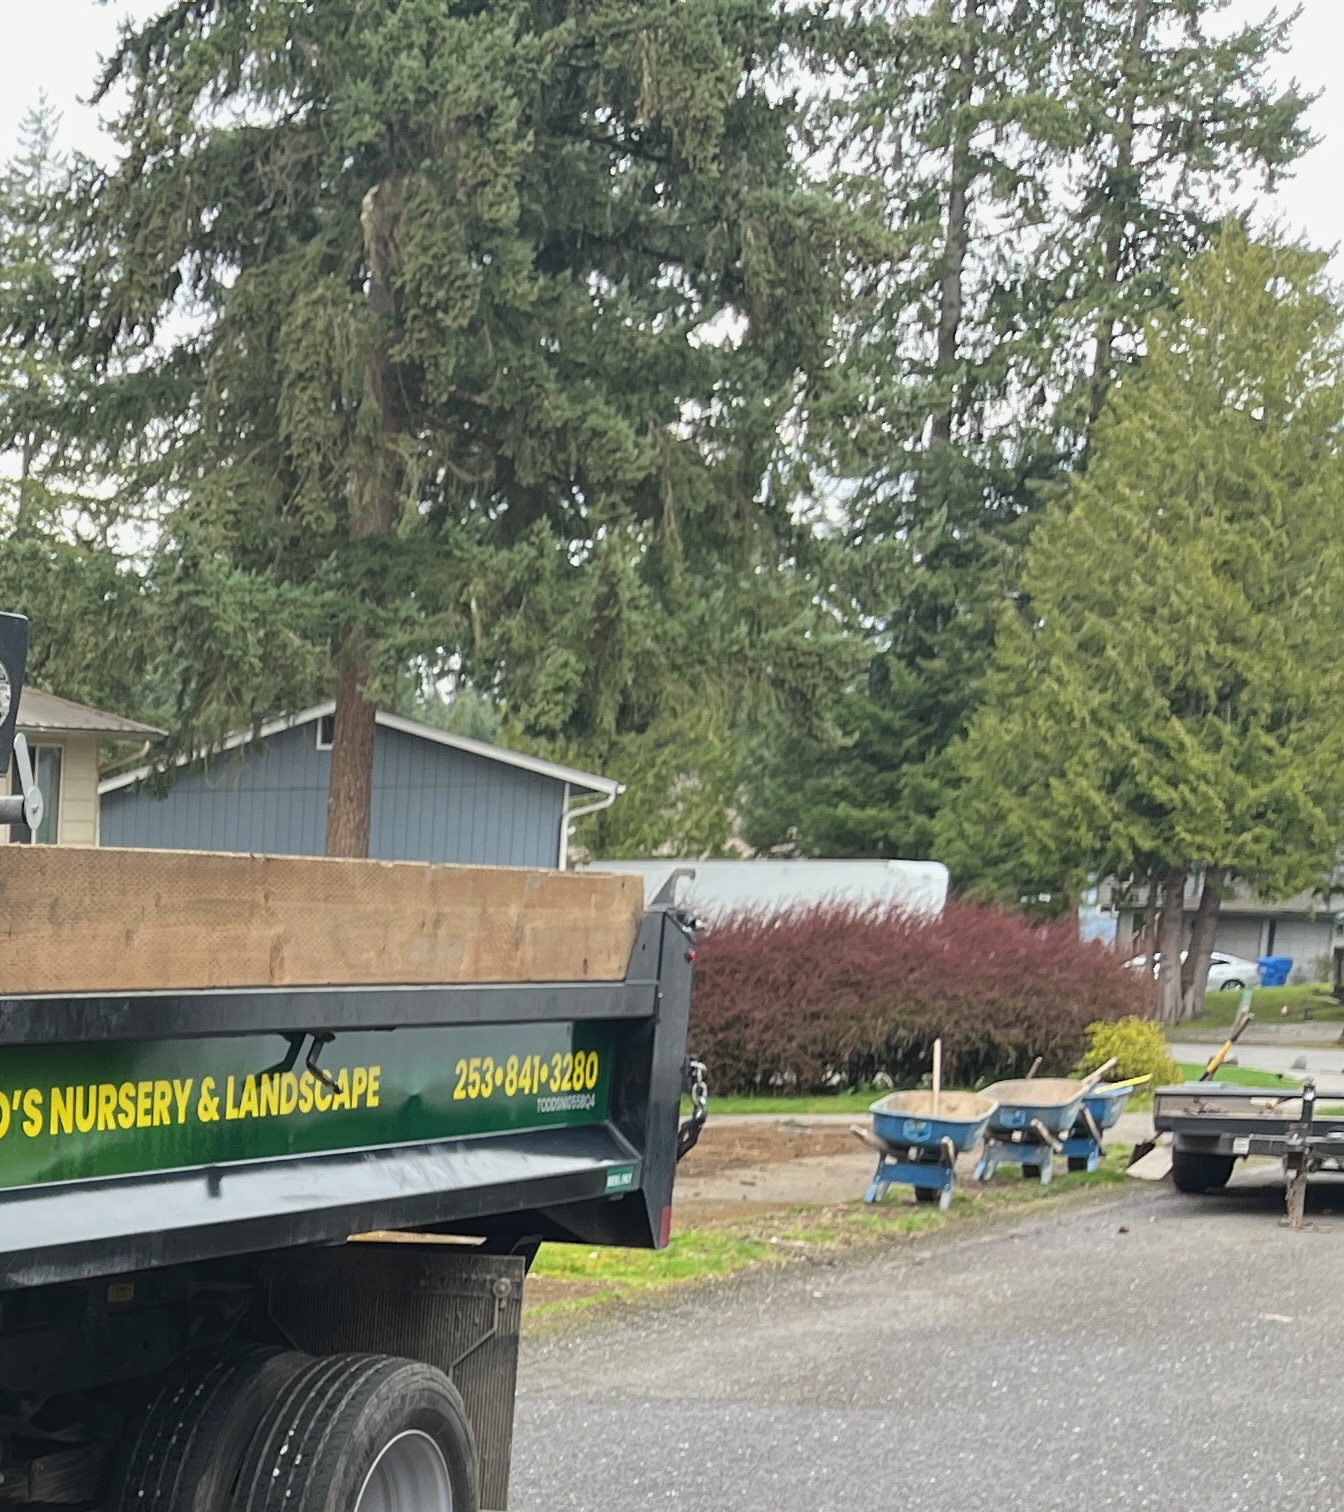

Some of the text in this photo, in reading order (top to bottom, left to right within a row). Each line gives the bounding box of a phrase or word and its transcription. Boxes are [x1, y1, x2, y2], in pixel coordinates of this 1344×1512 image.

[49, 1078, 194, 1135] NURSERY
[197, 1076, 221, 1123] &
[225, 1065, 382, 1121] LANDSCAPE
